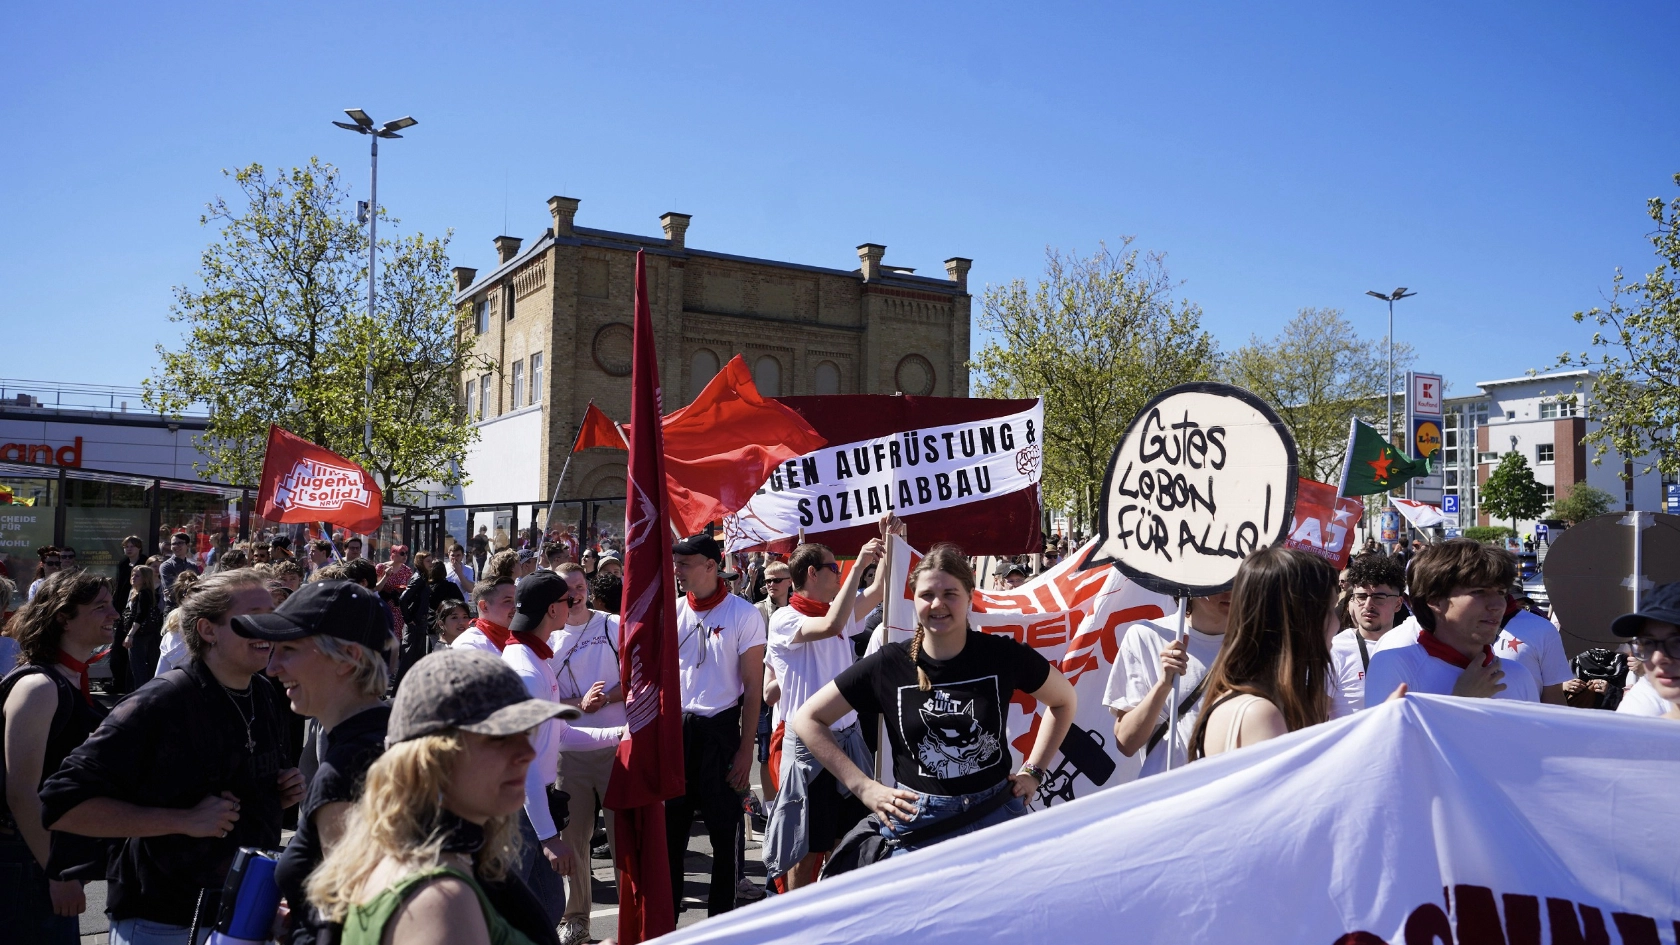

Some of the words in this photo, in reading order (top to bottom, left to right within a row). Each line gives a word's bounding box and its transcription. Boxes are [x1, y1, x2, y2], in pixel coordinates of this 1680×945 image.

[755, 456, 820, 496] GEN
[836, 423, 1015, 480] AUFRÜSTUNG
[1026, 419, 1036, 444] &
[798, 465, 992, 527] SOZIALABBAU
[1445, 497, 1454, 512] P
[1118, 504, 1172, 562] FÜR
[922, 698, 962, 713] GUILT
[934, 690, 951, 702] THE
